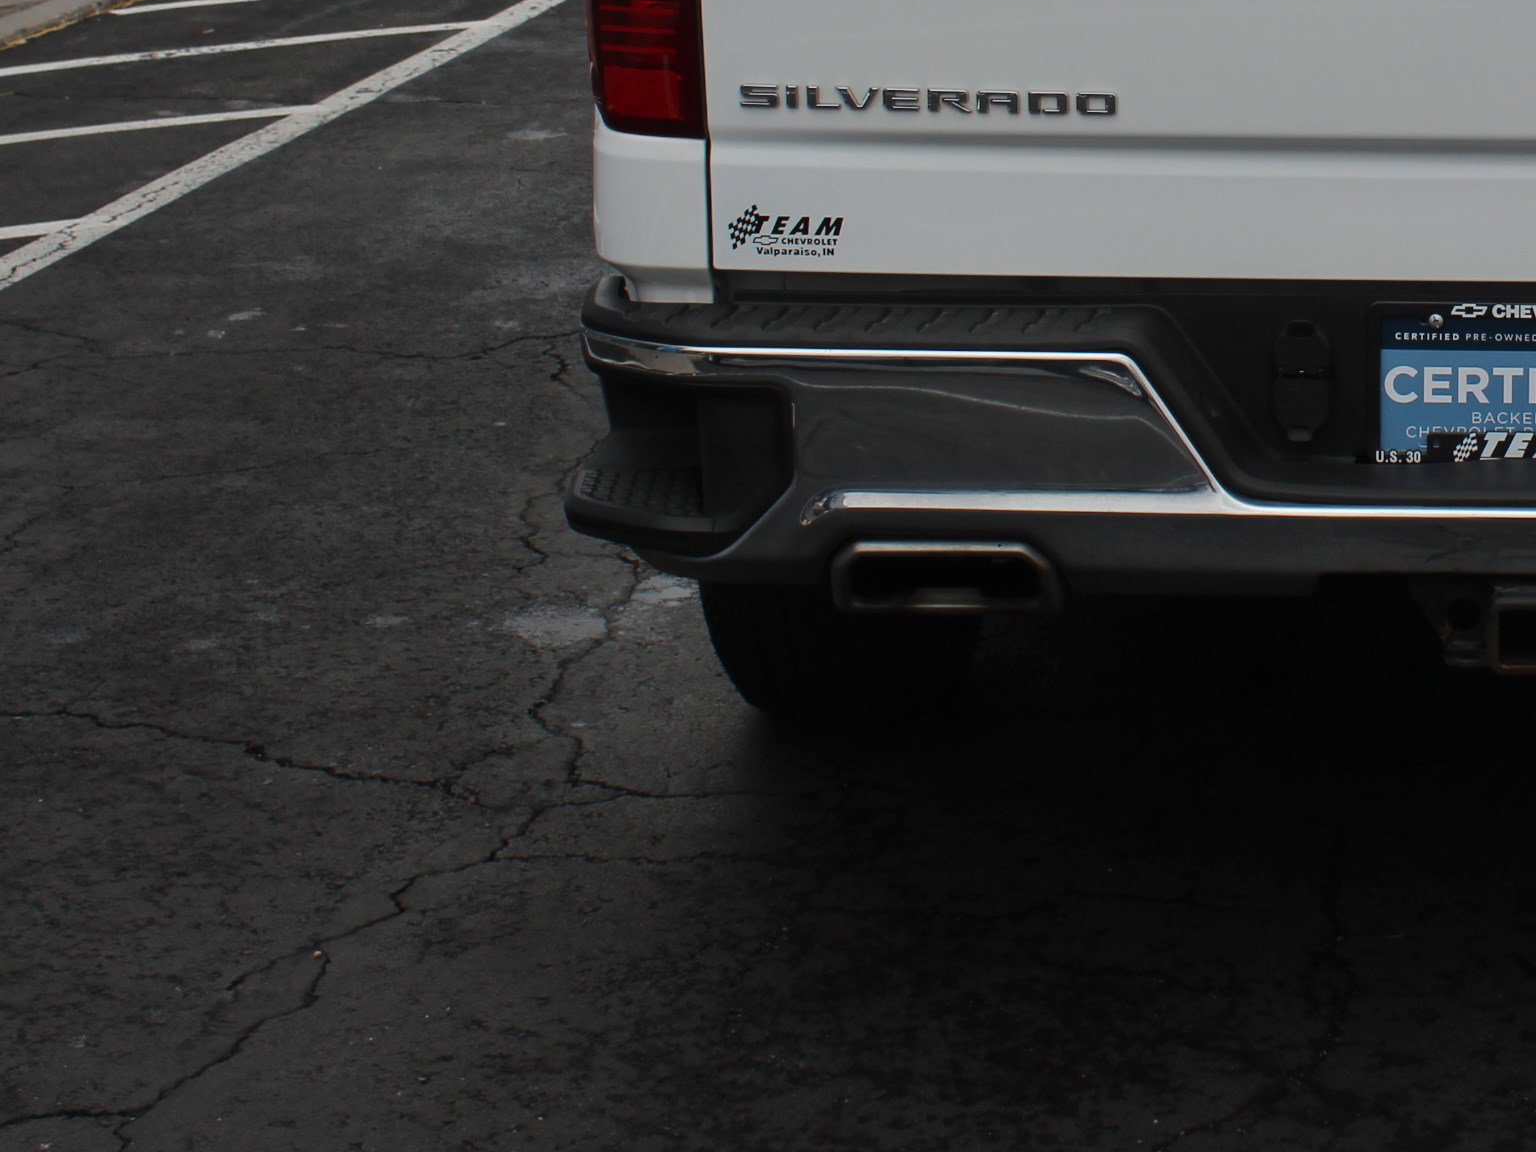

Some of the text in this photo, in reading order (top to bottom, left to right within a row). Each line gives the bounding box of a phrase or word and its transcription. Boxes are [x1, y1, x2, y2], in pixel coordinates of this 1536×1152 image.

[739, 83, 1118, 116] SILVERADO
[752, 215, 844, 236] TEAM
[781, 237, 838, 246] CHEVROLET
[756, 246, 835, 258] Valparaiso, IN
[1394, 332, 1460, 341] CERTIFIED
[1375, 450, 1422, 463] U.S. 30
